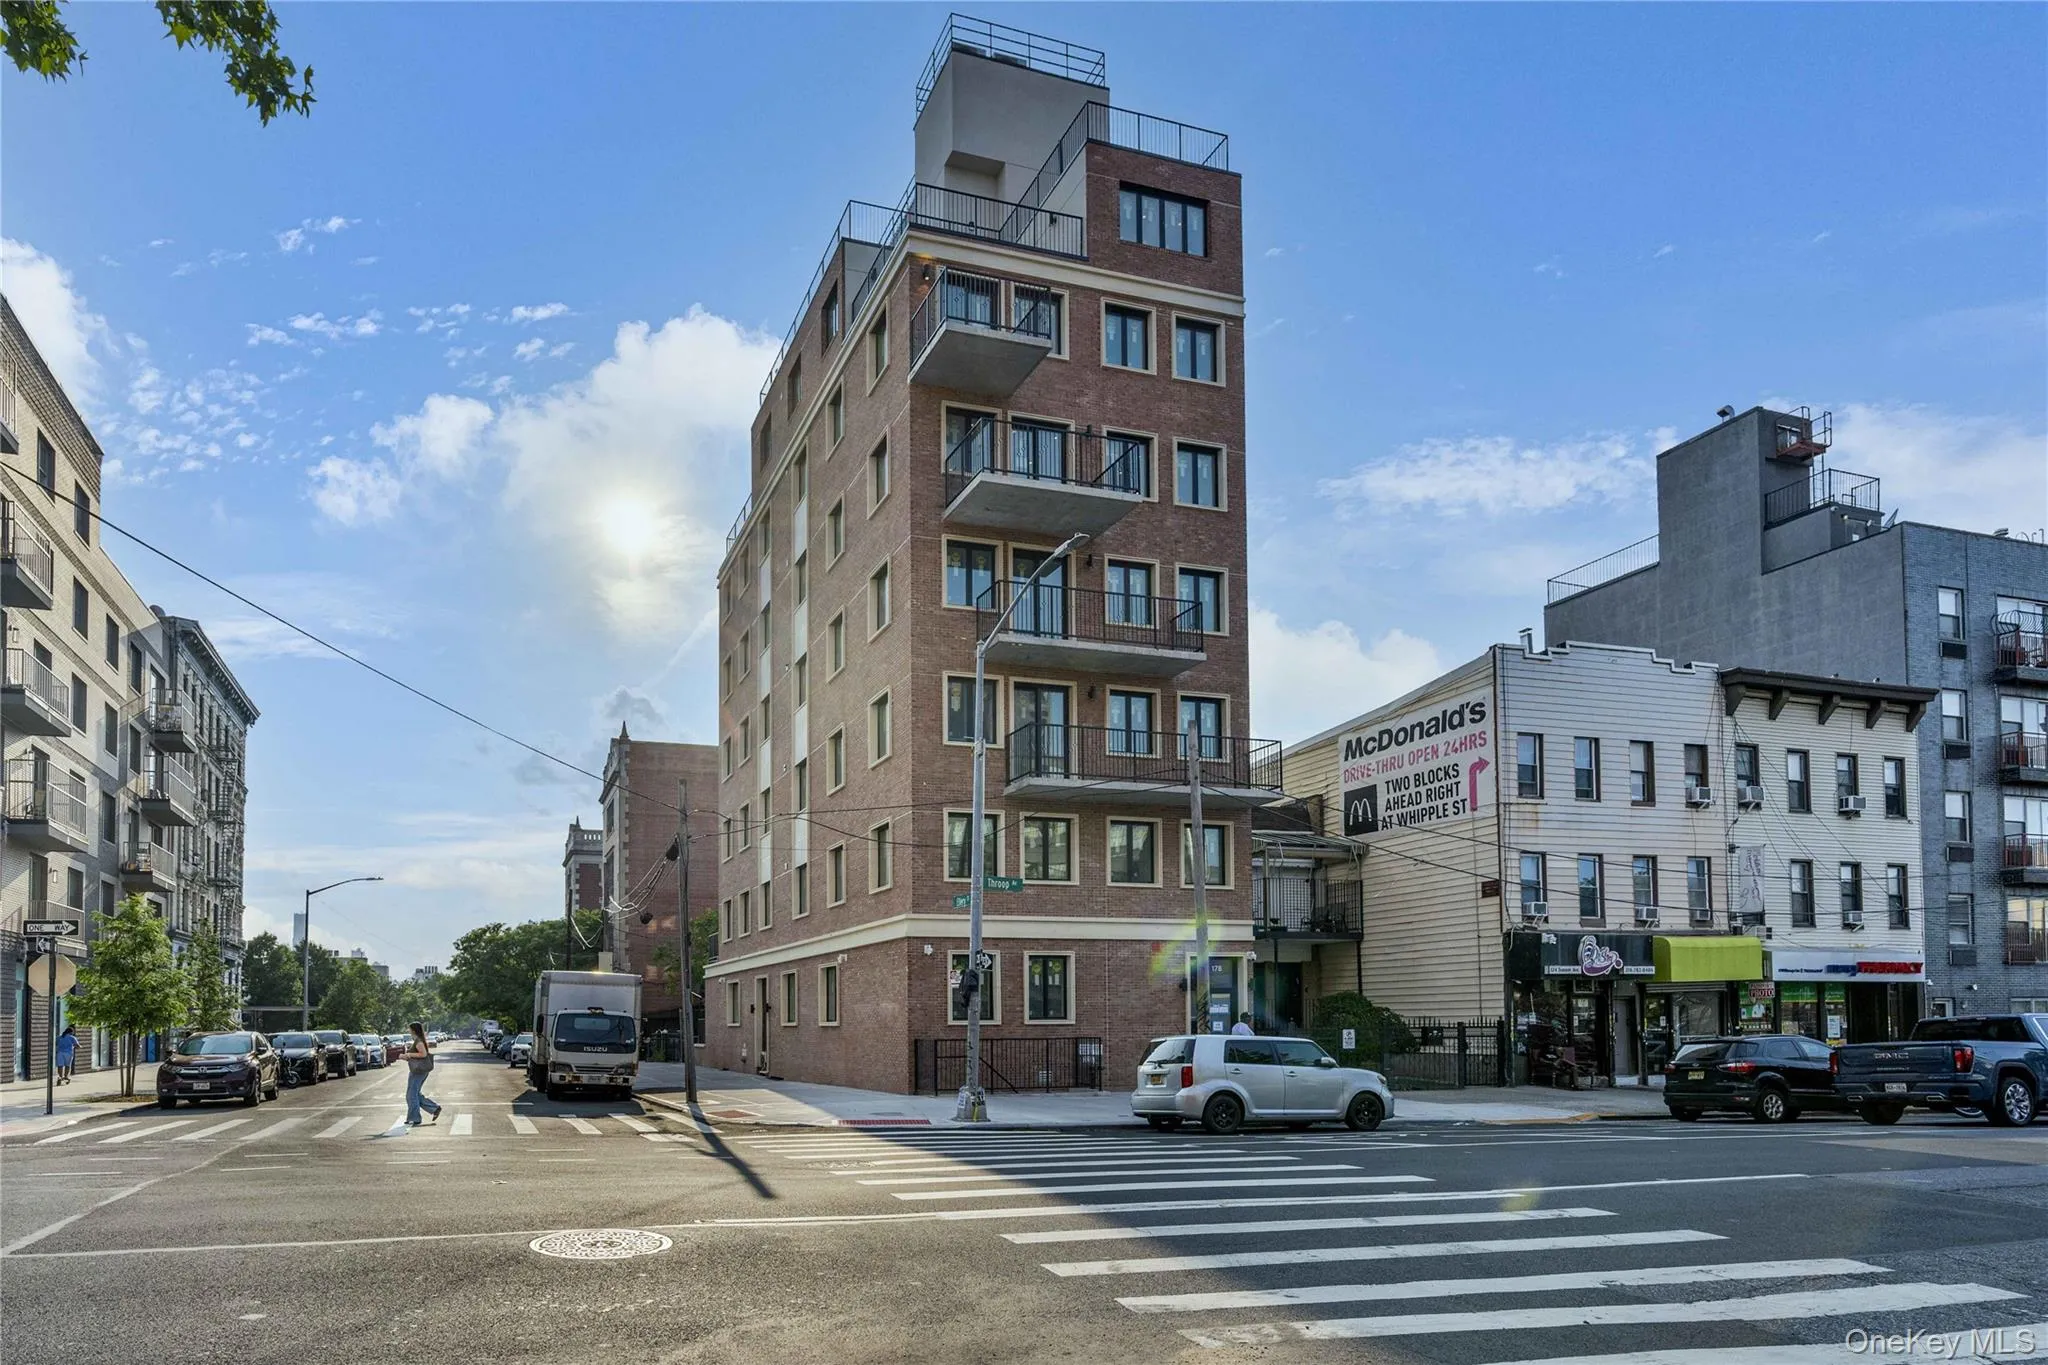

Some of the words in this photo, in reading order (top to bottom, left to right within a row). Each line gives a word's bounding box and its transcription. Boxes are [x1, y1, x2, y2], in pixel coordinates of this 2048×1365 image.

[1344, 701, 1487, 762] McDonald's
[1343, 755, 1404, 784] DRIVE-THRU
[1408, 744, 1439, 765] OPEN
[1443, 731, 1488, 758] 24HRS
[1385, 776, 1410, 795] TWO
[1414, 763, 1460, 787] BLOCKS
[1385, 792, 1422, 813] AHEAD
[1426, 781, 1461, 801] RIGHT
[1381, 814, 1394, 831] AT
[1396, 804, 1449, 827] WHIPPLE
[1453, 799, 1467, 816] ST
[987, 878, 1010, 890] Throop
[28, 924, 44, 932] ONE
[1749, 989, 1774, 997] PHOTO
